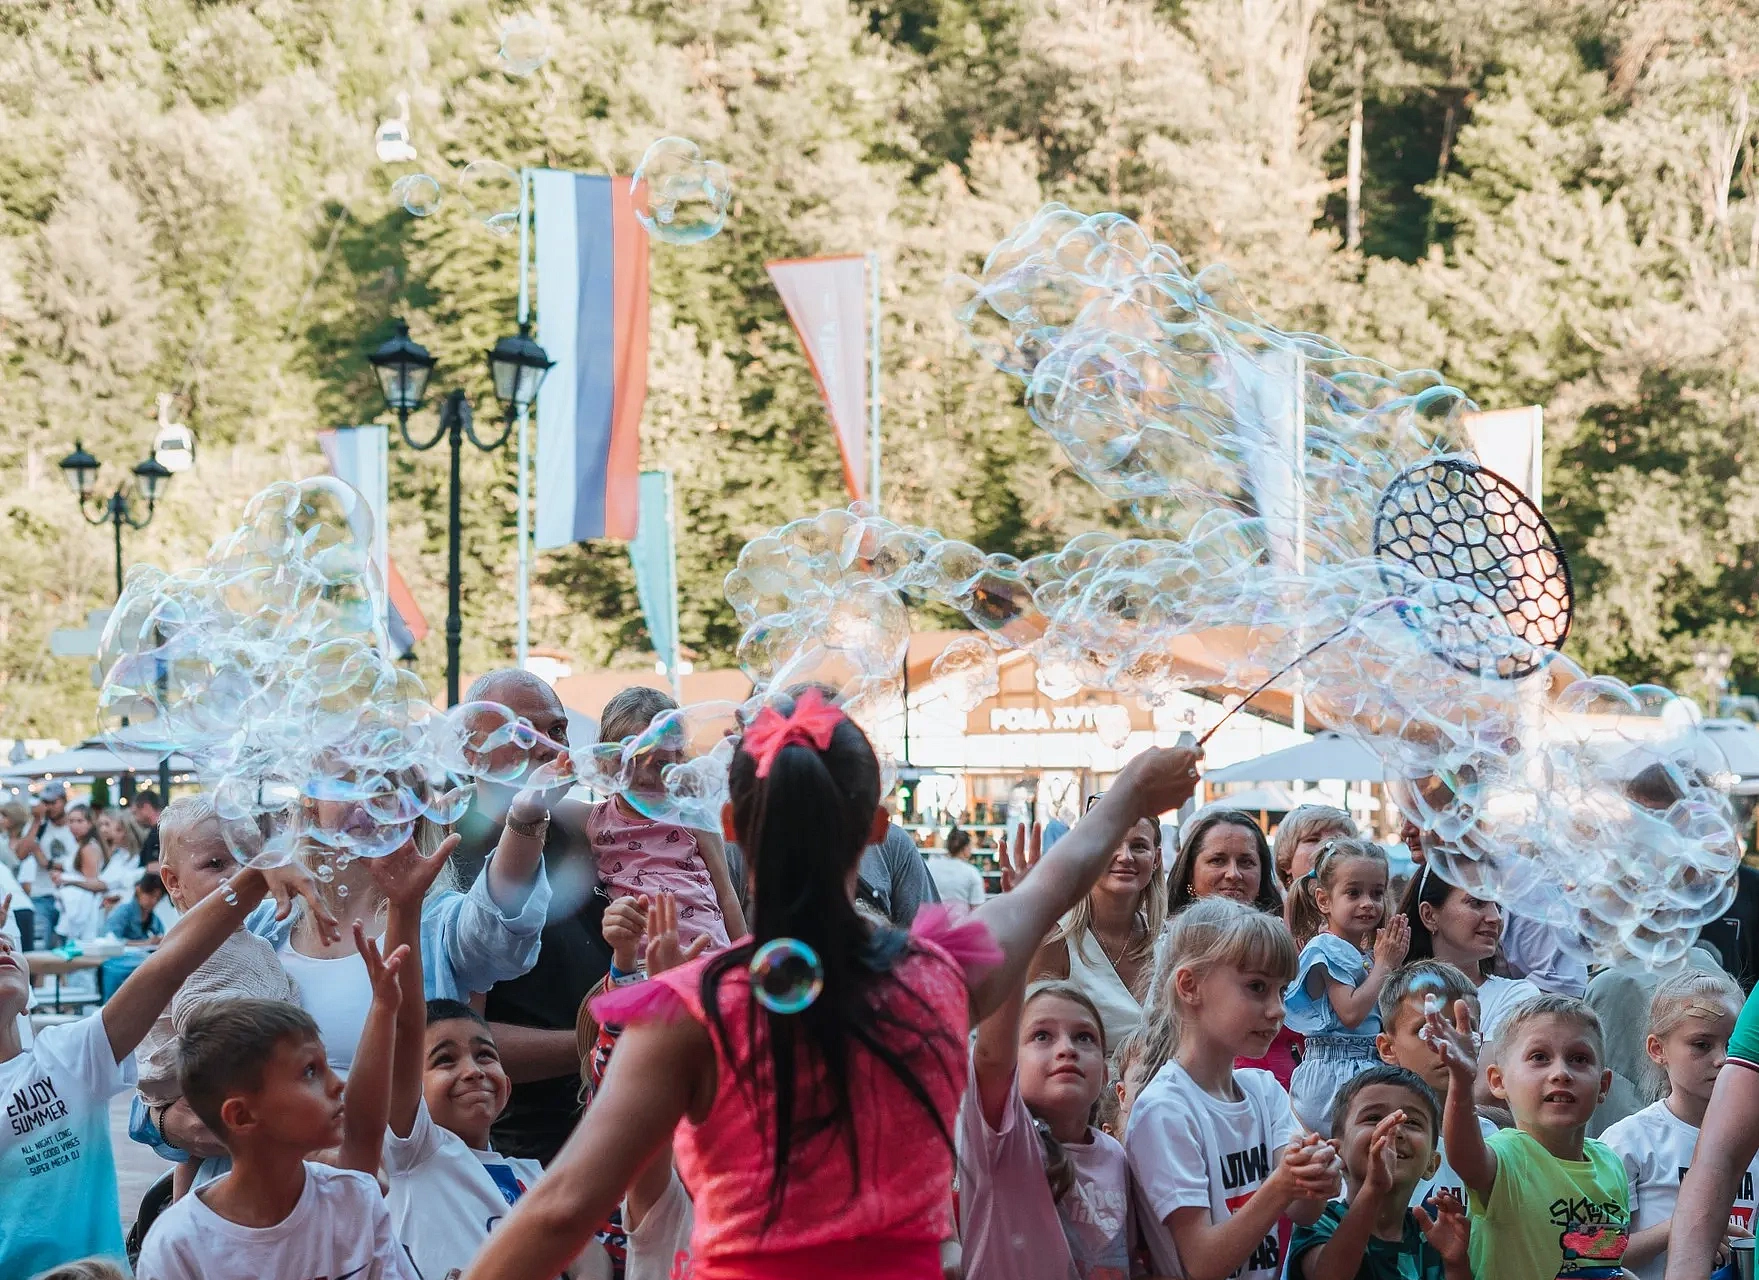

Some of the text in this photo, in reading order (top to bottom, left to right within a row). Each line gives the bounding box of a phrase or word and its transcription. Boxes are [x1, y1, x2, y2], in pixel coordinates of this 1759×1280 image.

[6, 1076, 58, 1117] ENJOY
[11, 1100, 68, 1135] SUMMER
[21, 1128, 73, 1155] ALL NIGHT LONG
[25, 1137, 81, 1166] ONLY GOOD VIBES
[29, 1150, 80, 1176] SUPER MEGA DJ
